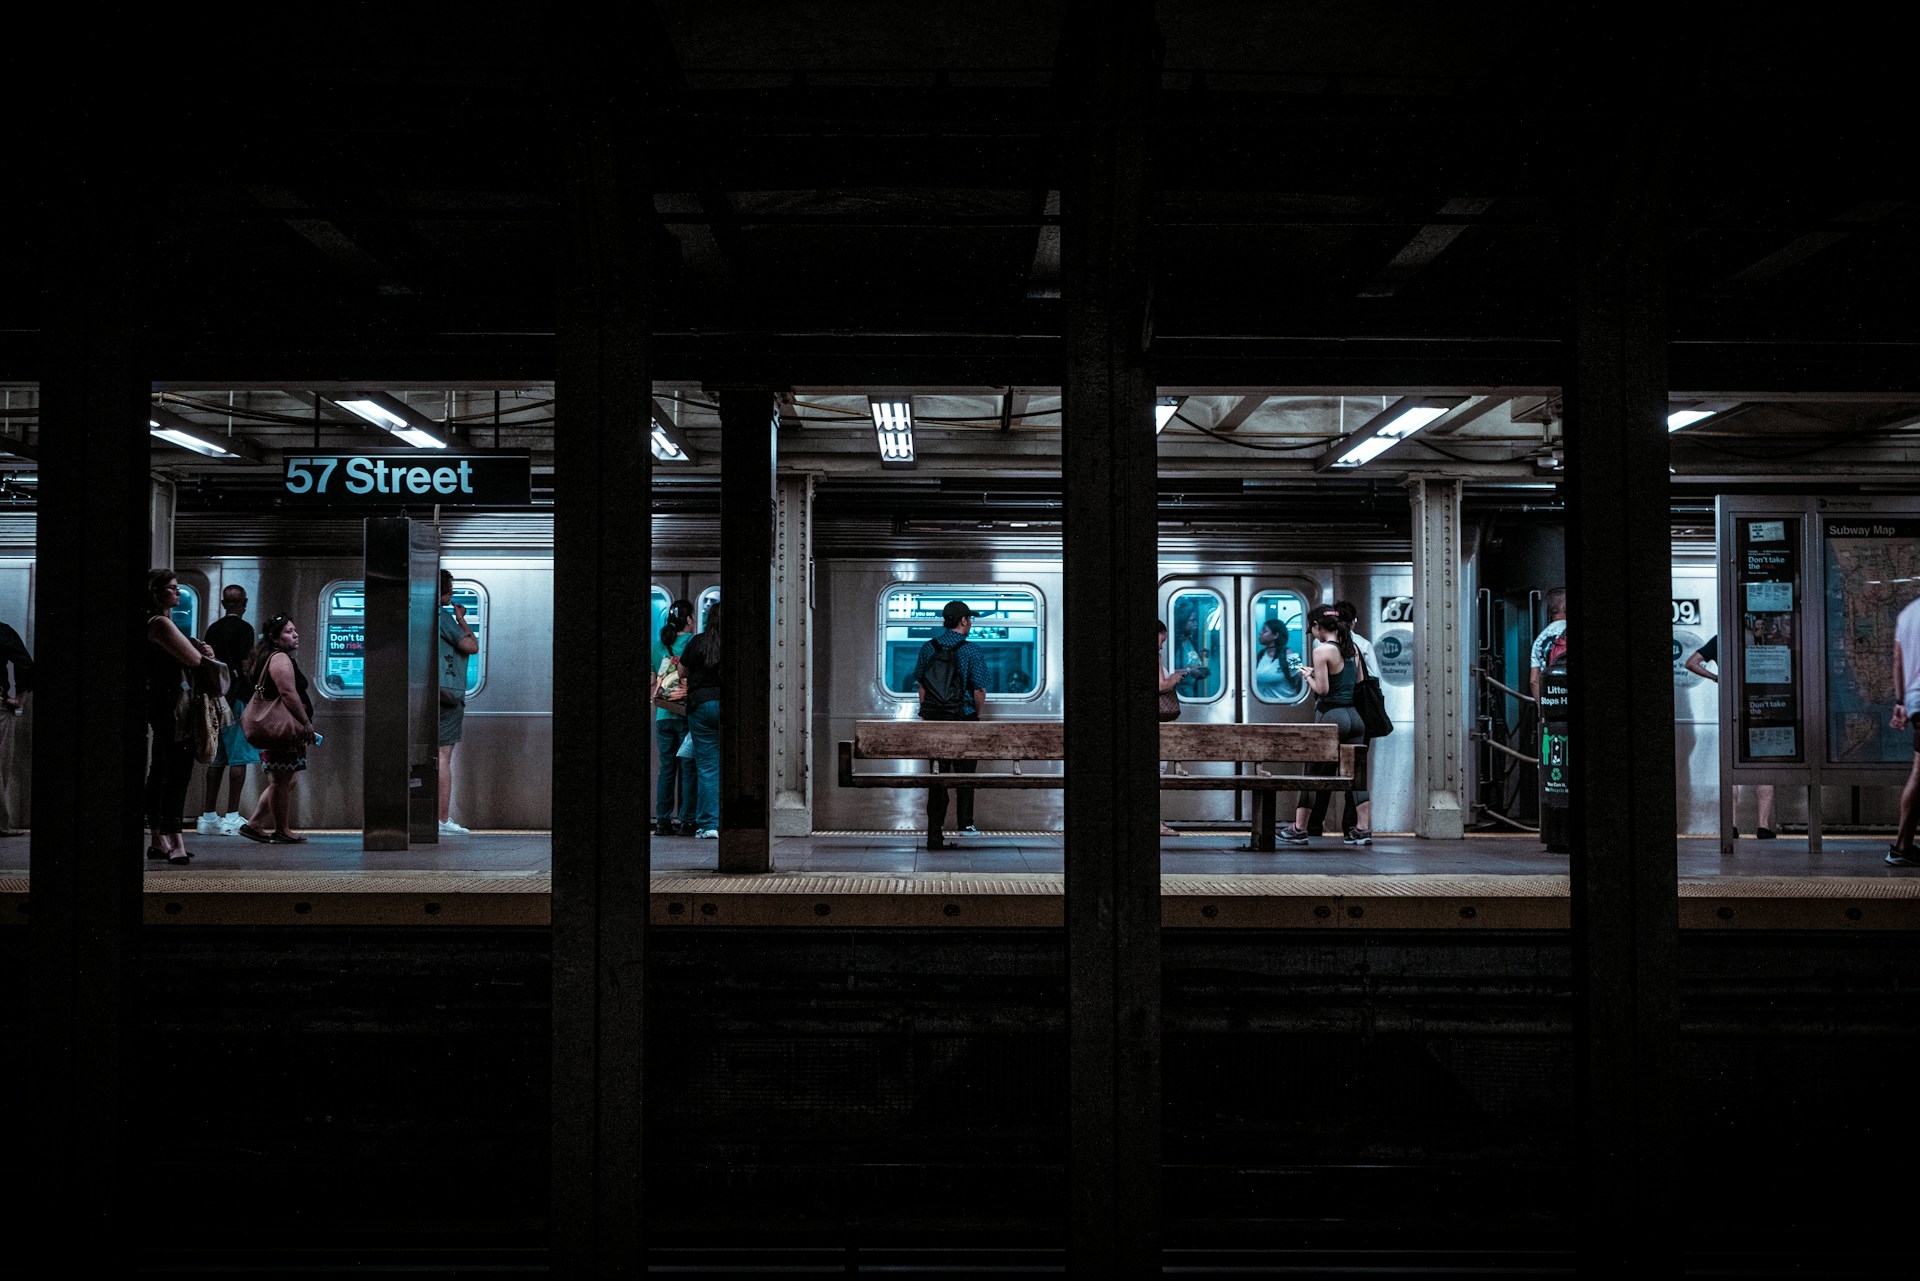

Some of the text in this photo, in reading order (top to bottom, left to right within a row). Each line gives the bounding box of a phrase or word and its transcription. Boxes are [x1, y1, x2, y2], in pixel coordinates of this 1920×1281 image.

[285, 457, 474, 494] 57 Street
[1828, 525, 1896, 537] Subway Map
[330, 633, 364, 642] Don't ta
[330, 642, 345, 650] the
[1541, 696, 1559, 706] Stops
